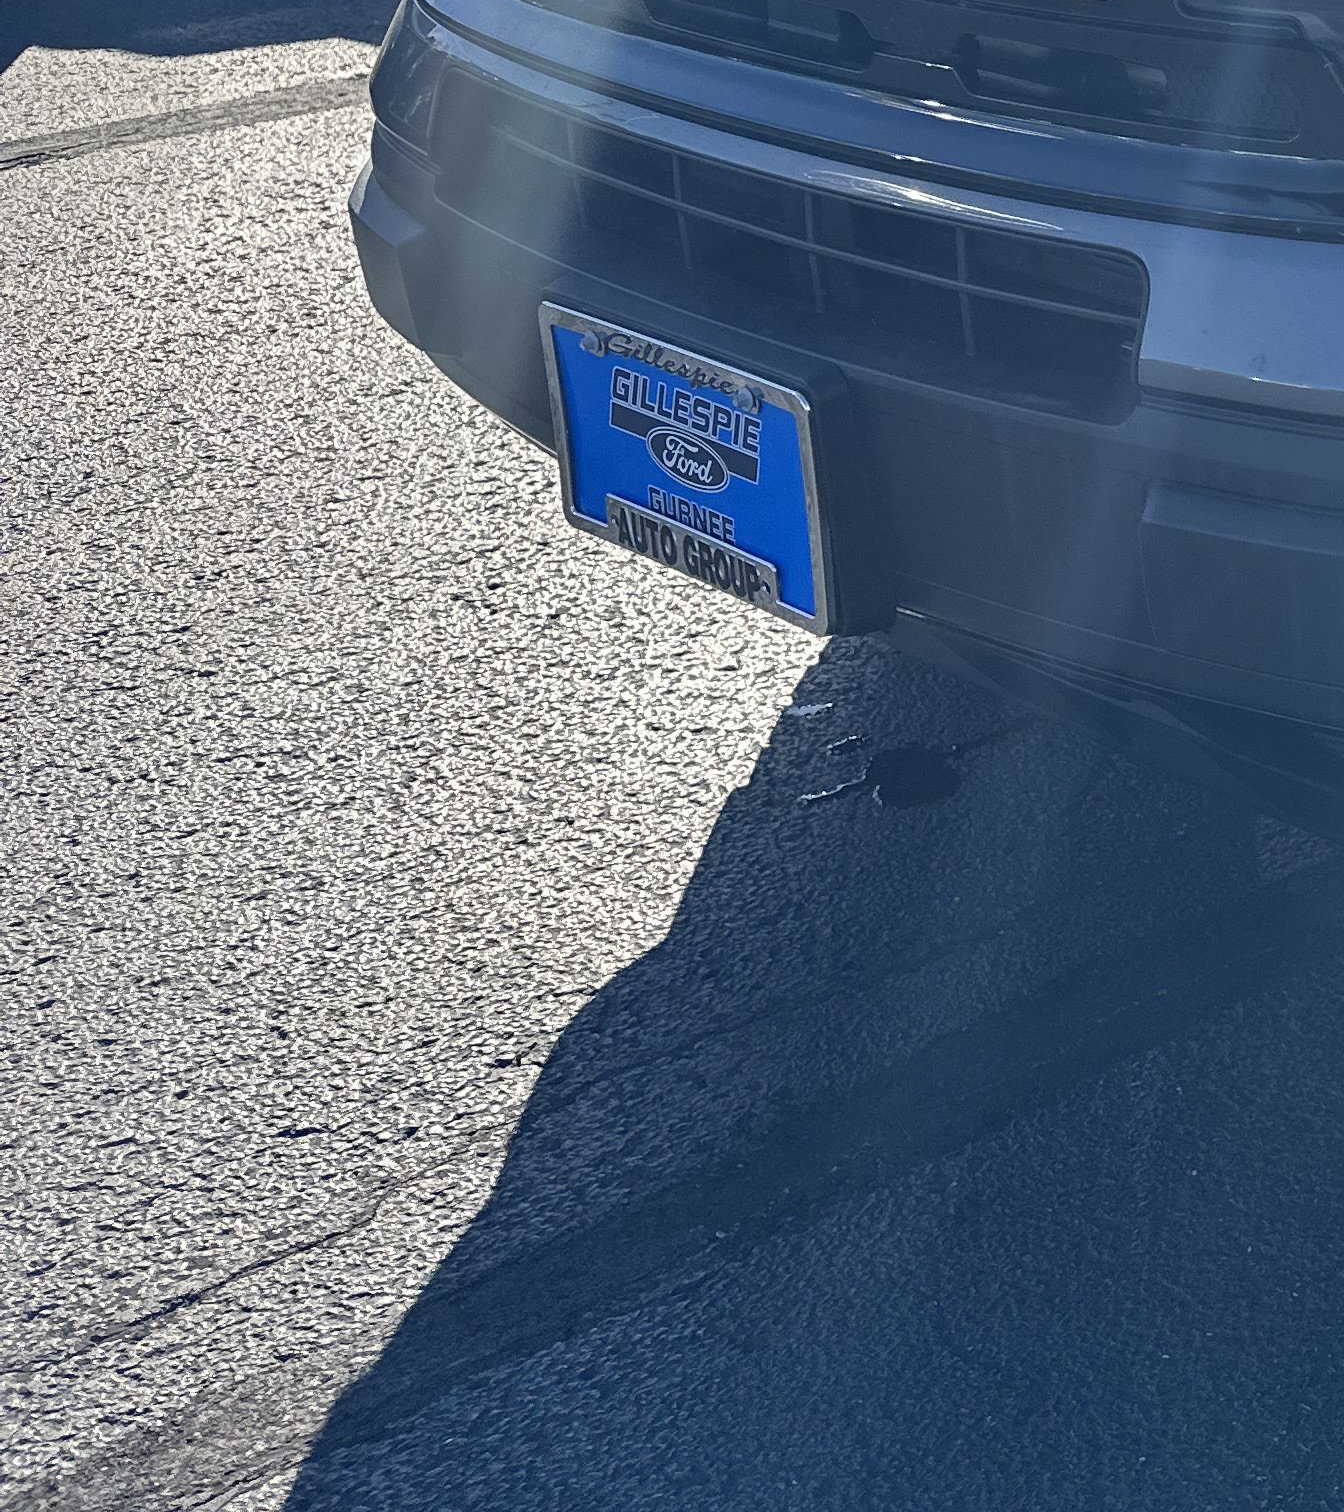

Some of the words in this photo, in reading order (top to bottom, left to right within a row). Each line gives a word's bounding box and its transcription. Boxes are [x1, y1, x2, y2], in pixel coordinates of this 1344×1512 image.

[604, 332, 738, 397] Gillespie
[611, 367, 762, 454] GILLESPIE
[661, 434, 715, 484] Ford
[647, 485, 736, 544] GURNEE
[616, 506, 677, 565] AUTO
[683, 537, 763, 603] GROUP
